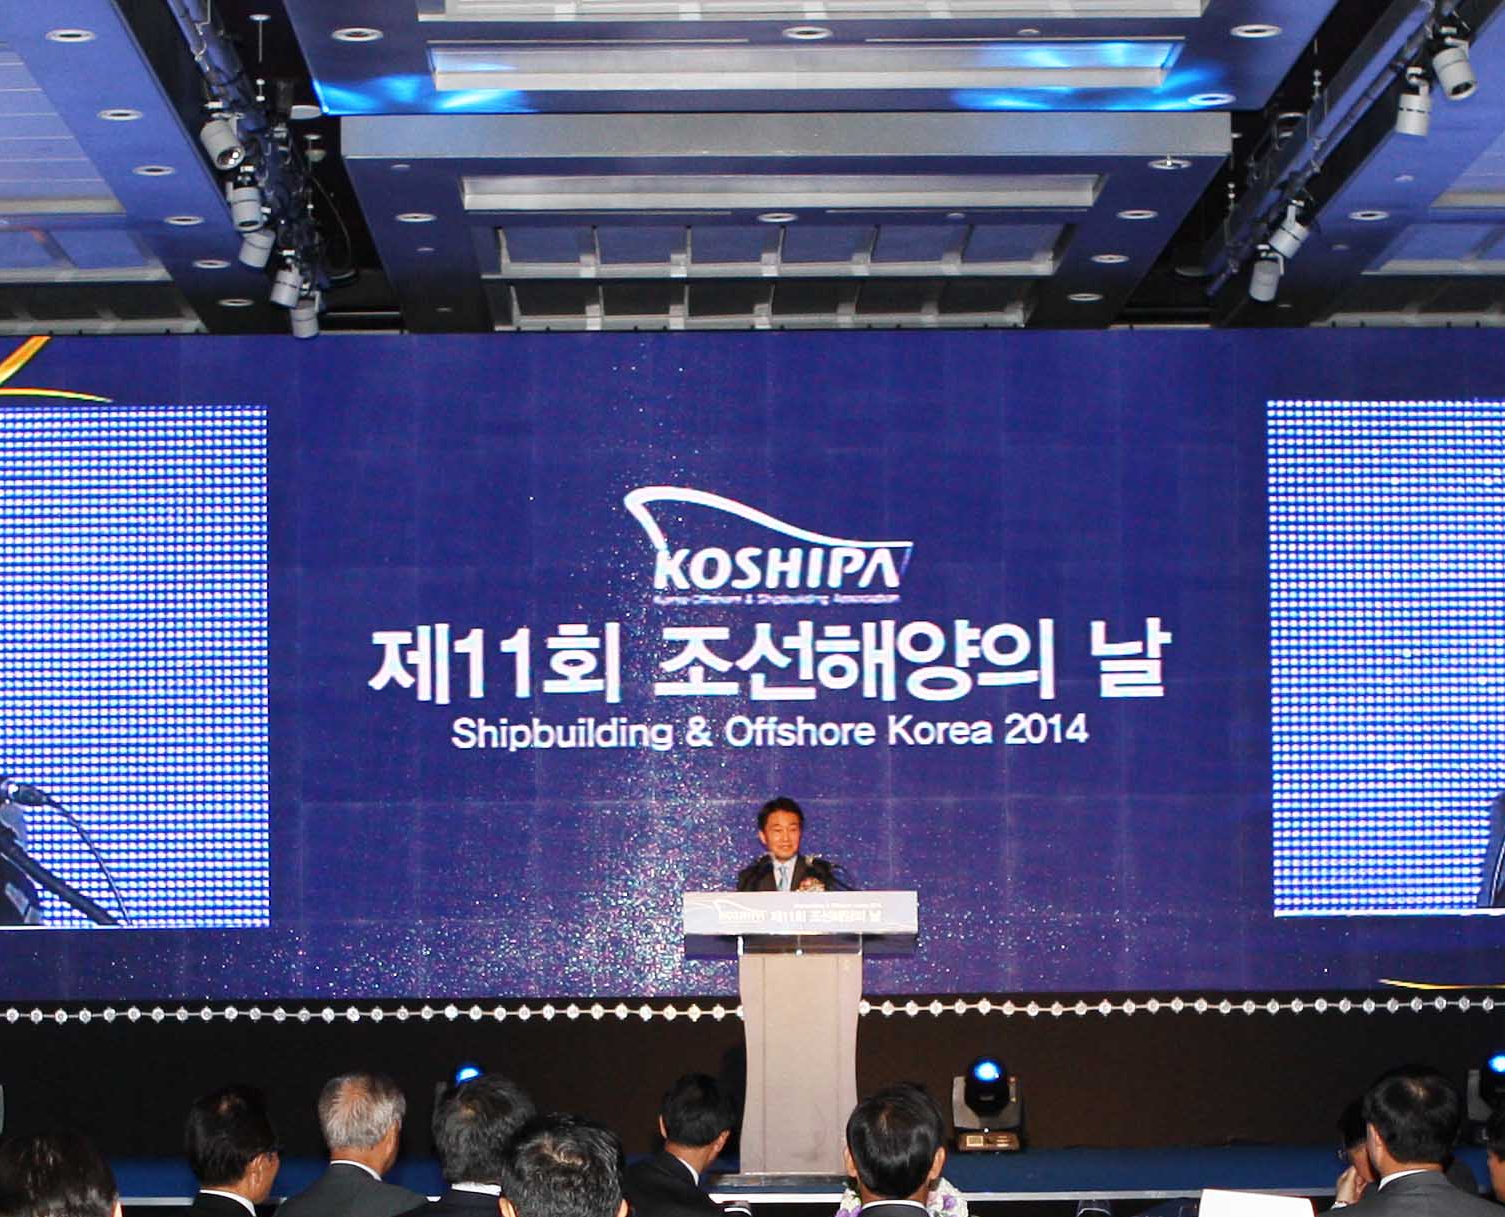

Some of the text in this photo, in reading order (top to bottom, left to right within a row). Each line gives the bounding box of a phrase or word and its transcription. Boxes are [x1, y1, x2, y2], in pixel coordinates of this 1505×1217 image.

[653, 547, 901, 590] KOSHIPA
[369, 616, 1173, 705] 제11회 조선해양의 날
[451, 712, 1090, 752] Shipbuilding & Offshore Korea 2014
